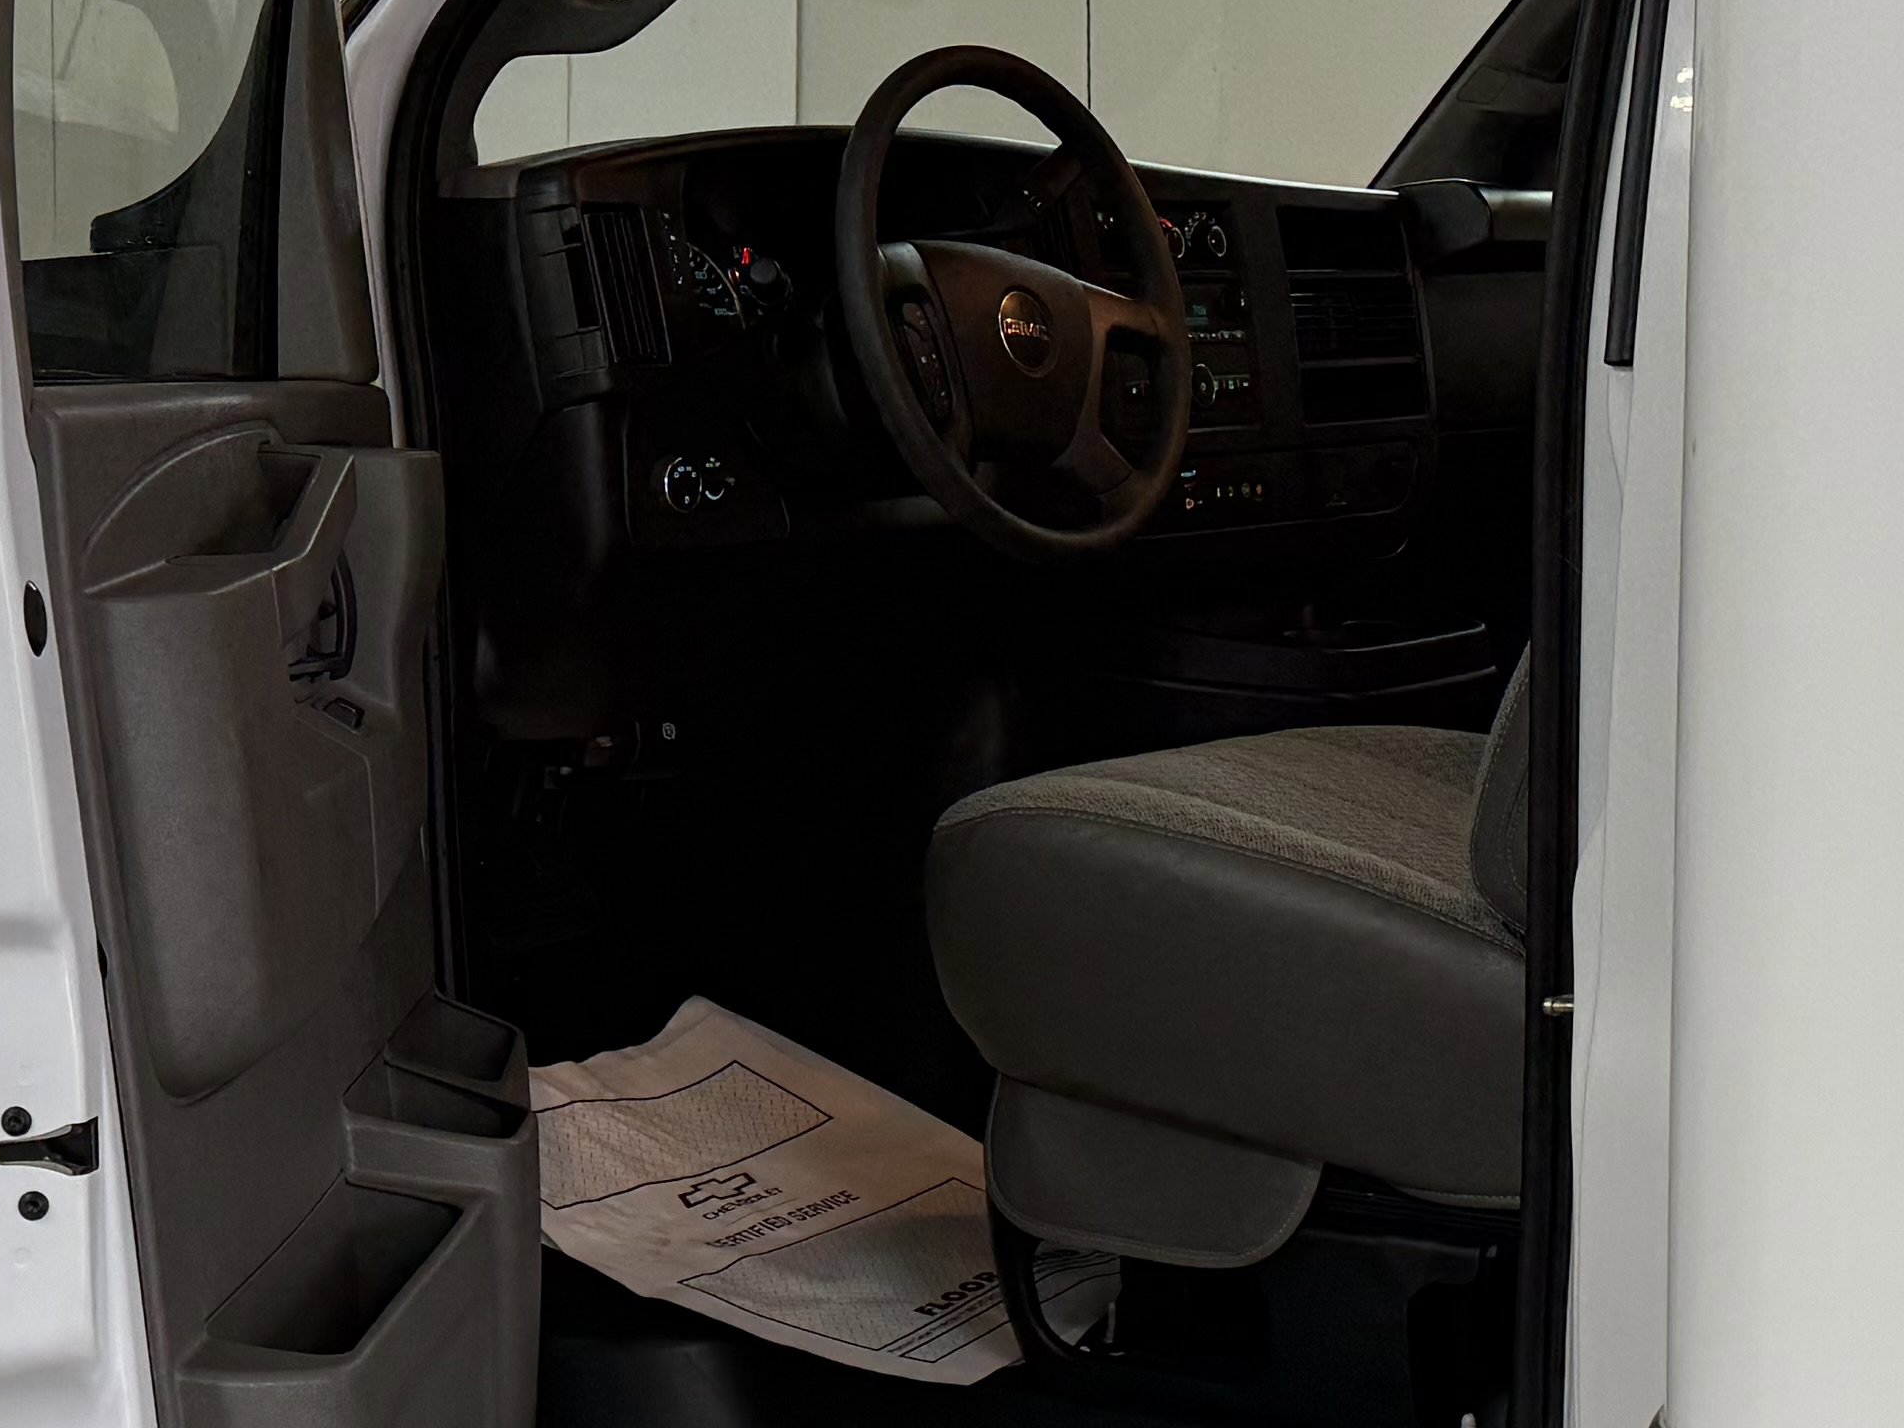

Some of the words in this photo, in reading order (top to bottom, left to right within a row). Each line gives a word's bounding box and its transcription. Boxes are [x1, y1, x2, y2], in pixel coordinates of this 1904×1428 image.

[702, 1187, 783, 1220] CHEVROLET
[787, 1190, 861, 1221] SERVICE
[912, 1272, 999, 1316] FLOOR
